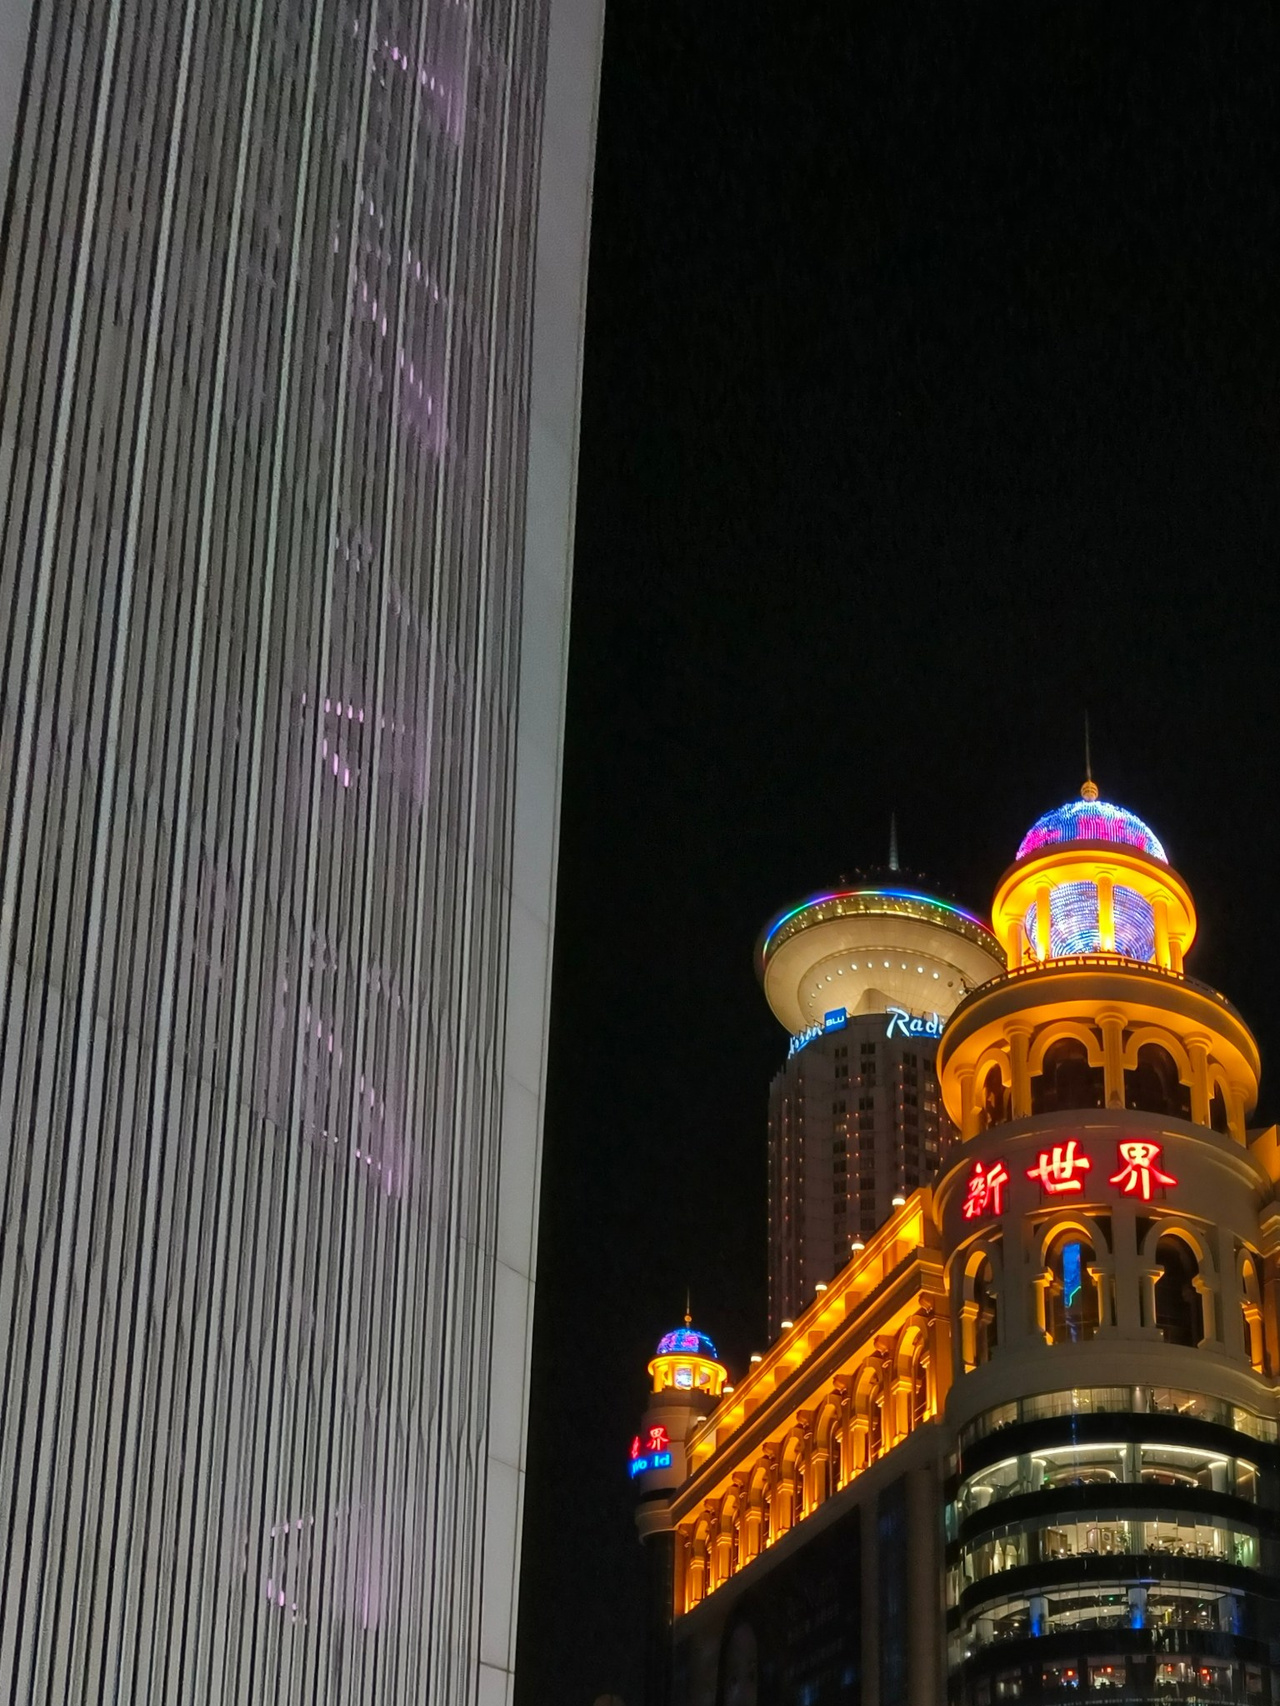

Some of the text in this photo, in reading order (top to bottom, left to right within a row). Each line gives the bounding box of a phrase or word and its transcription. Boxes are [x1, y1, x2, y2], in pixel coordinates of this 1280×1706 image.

[826, 1015, 845, 1027] BLU
[963, 1140, 1178, 1218] 新世界
